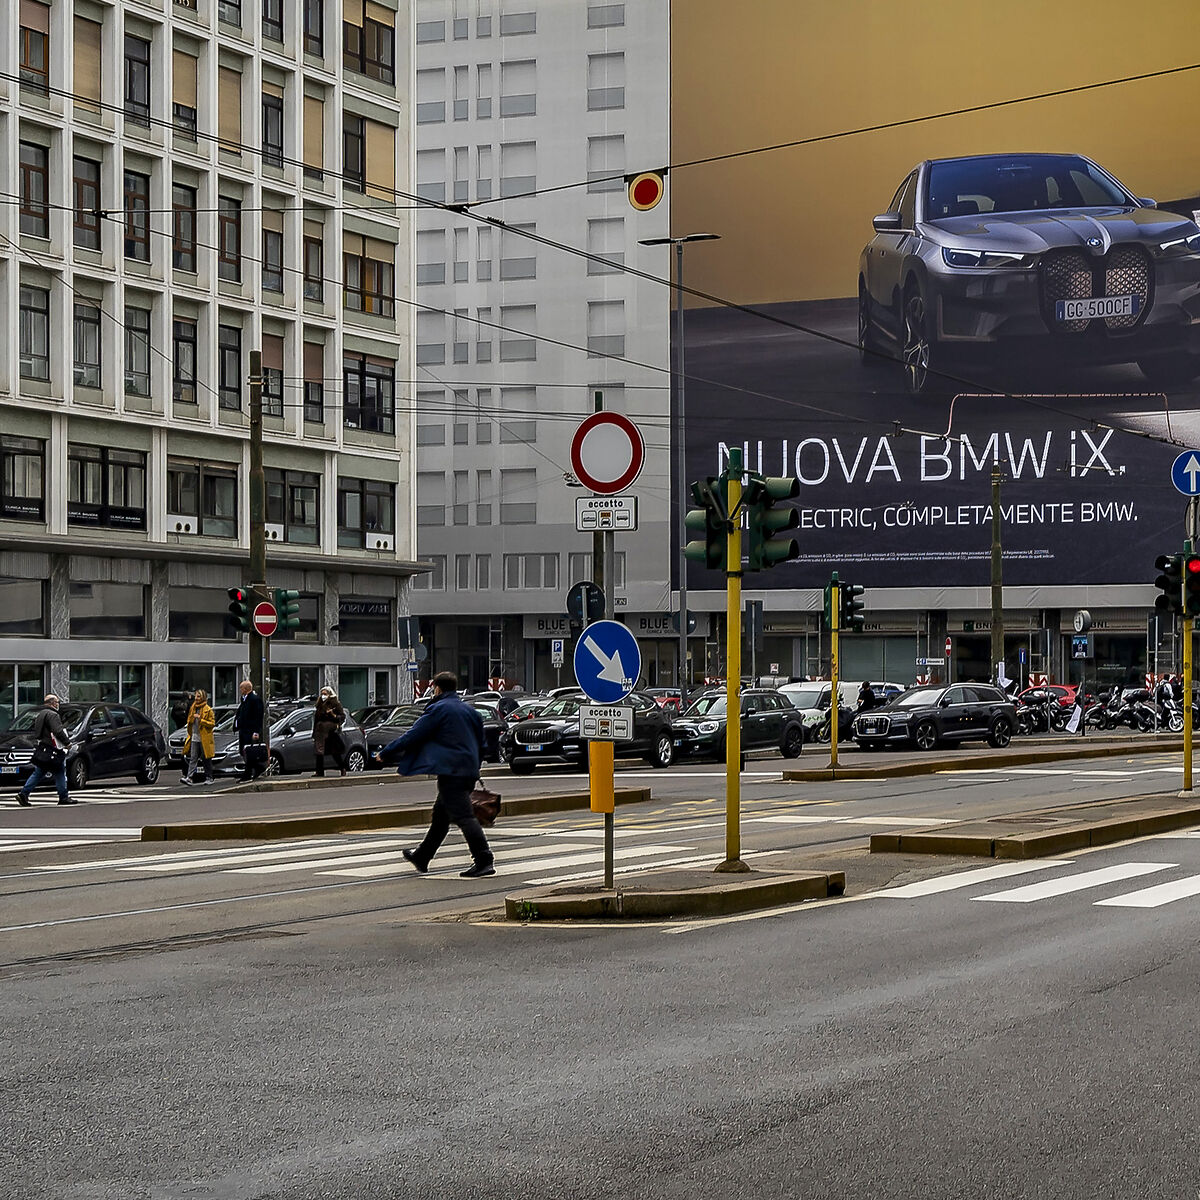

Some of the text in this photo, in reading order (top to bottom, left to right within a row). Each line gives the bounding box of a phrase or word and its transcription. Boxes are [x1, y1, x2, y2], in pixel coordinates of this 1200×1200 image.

[718, 436, 901, 486] NUOVA
[920, 430, 1052, 481] BMW
[588, 499, 623, 508] eccetto
[798, 501, 1138, 531] ECTRIC, COMPLETAMENTE BMW.
[538, 619, 565, 630] BLUE
[640, 618, 668, 629] BLUE
[554, 642, 560, 650] P
[589, 708, 622, 717] eccetto
